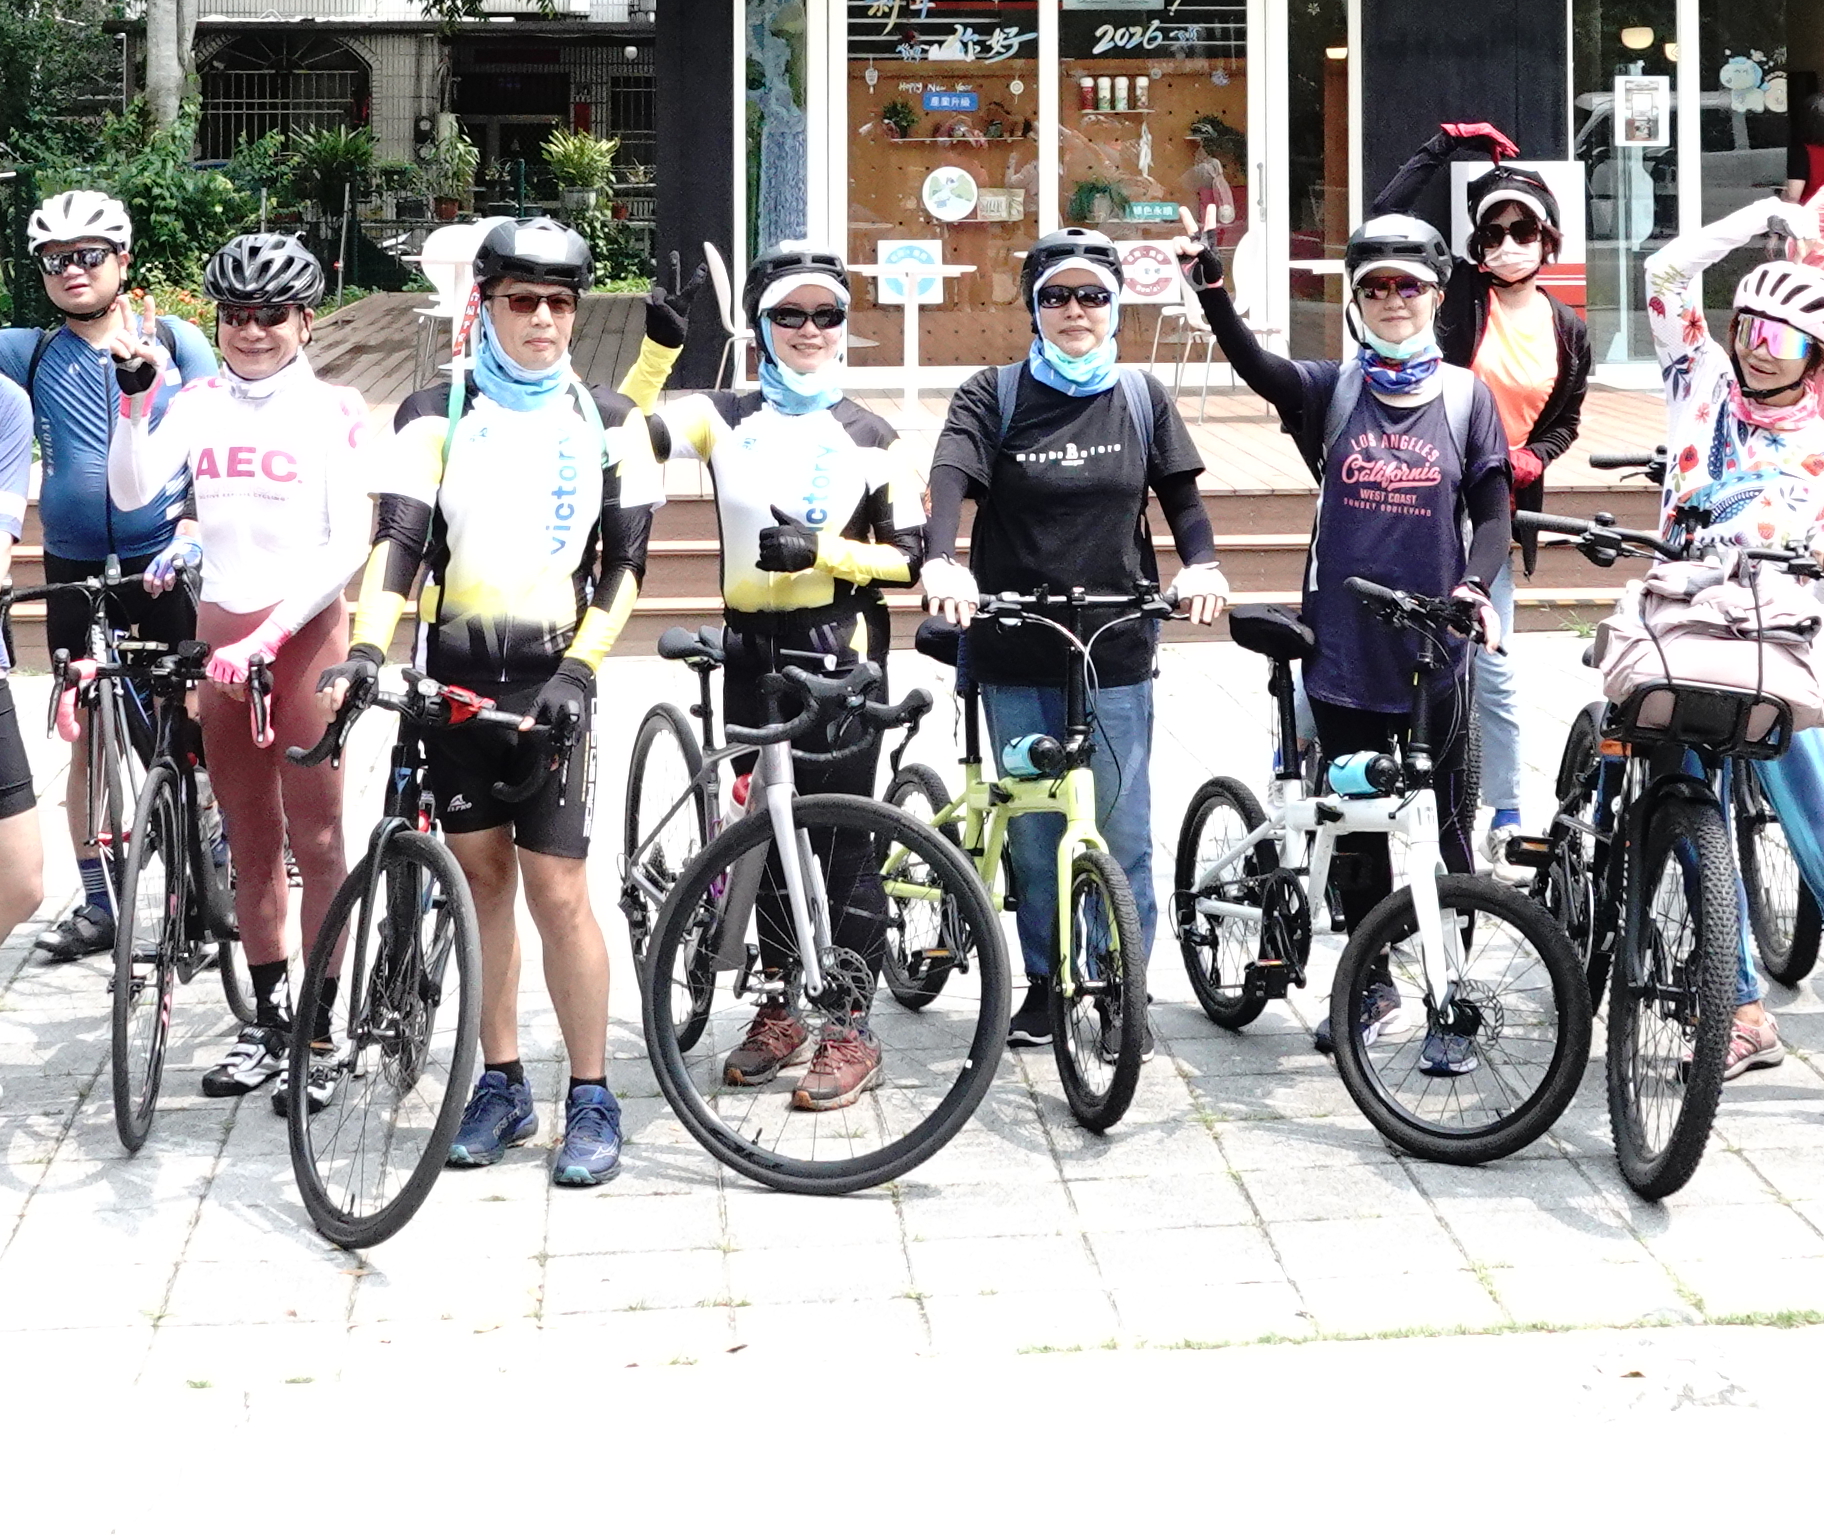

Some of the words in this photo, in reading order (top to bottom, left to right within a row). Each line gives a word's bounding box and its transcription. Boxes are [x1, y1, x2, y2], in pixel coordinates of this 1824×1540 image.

[1092, 20, 1163, 55] 2026
[897, 81, 923, 94] Happy
[1351, 433, 1376, 451] LOS
[1381, 434, 1440, 462] ANGELES
[802, 444, 838, 532] ictory
[1342, 454, 1441, 491] California
[546, 428, 578, 555] victory
[1360, 489, 1386, 502] WEST
[1388, 492, 1417, 505] COAST
